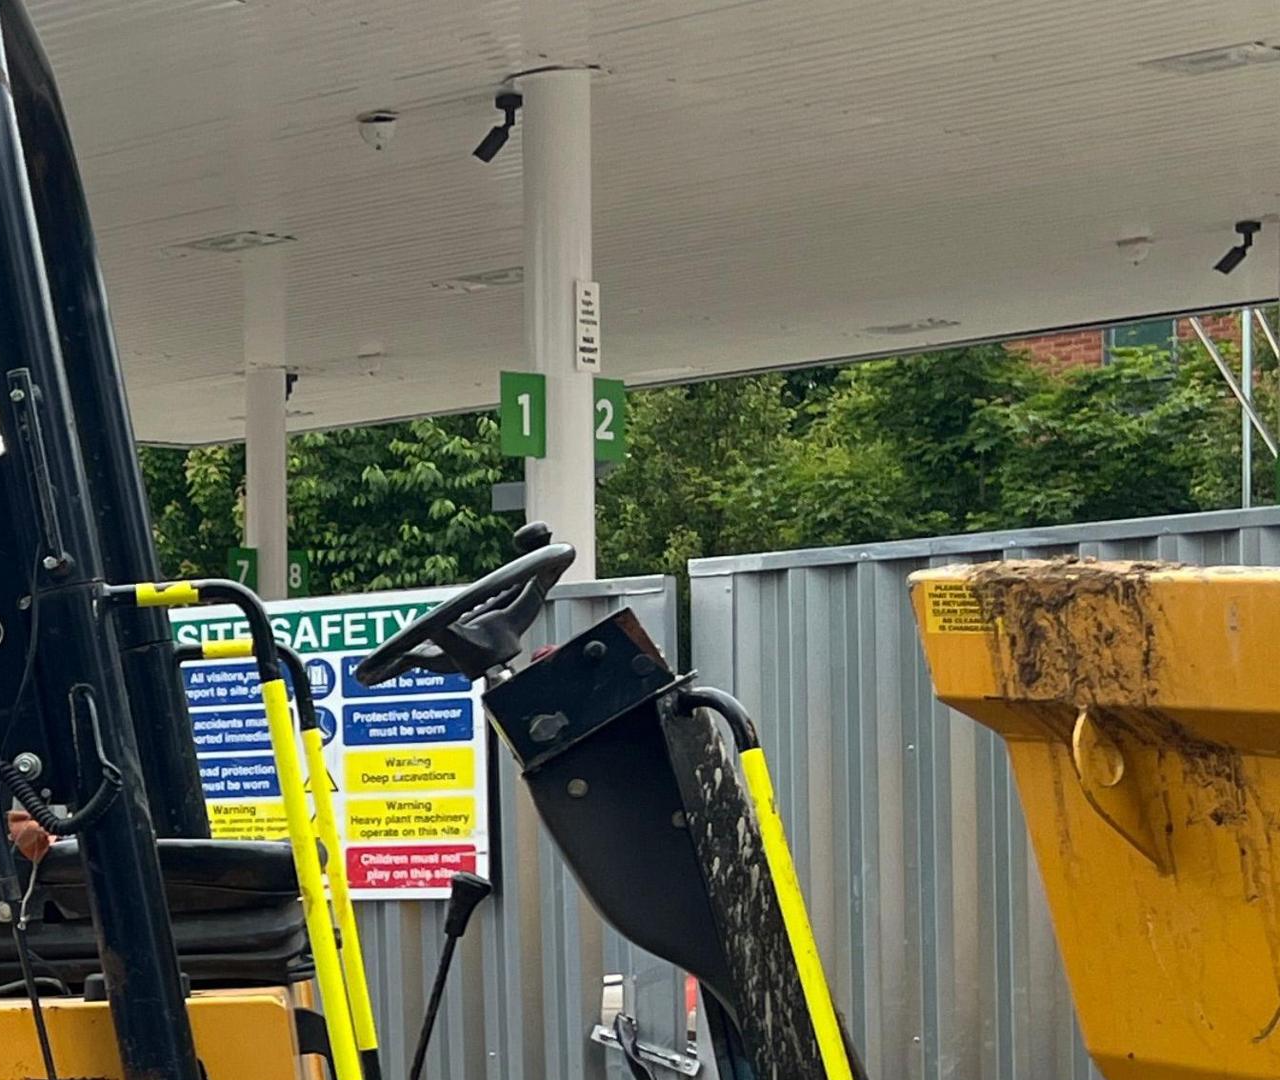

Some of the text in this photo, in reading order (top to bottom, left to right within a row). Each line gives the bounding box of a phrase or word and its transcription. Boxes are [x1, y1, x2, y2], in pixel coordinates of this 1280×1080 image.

[517, 393, 531, 436] 1
[595, 399, 614, 441] 2
[237, 560, 249, 584] 7
[289, 563, 301, 588] 8
[353, 706, 462, 723] Protective footwear
[369, 723, 446, 737] must be worn
[362, 773, 389, 784] Deep
[213, 805, 256, 816] Warning
[386, 800, 432, 812] Warning
[351, 812, 469, 825] Heavy plant machinery
[360, 828, 399, 840] operate
[402, 827, 416, 837] on
[418, 826, 438, 836] this
